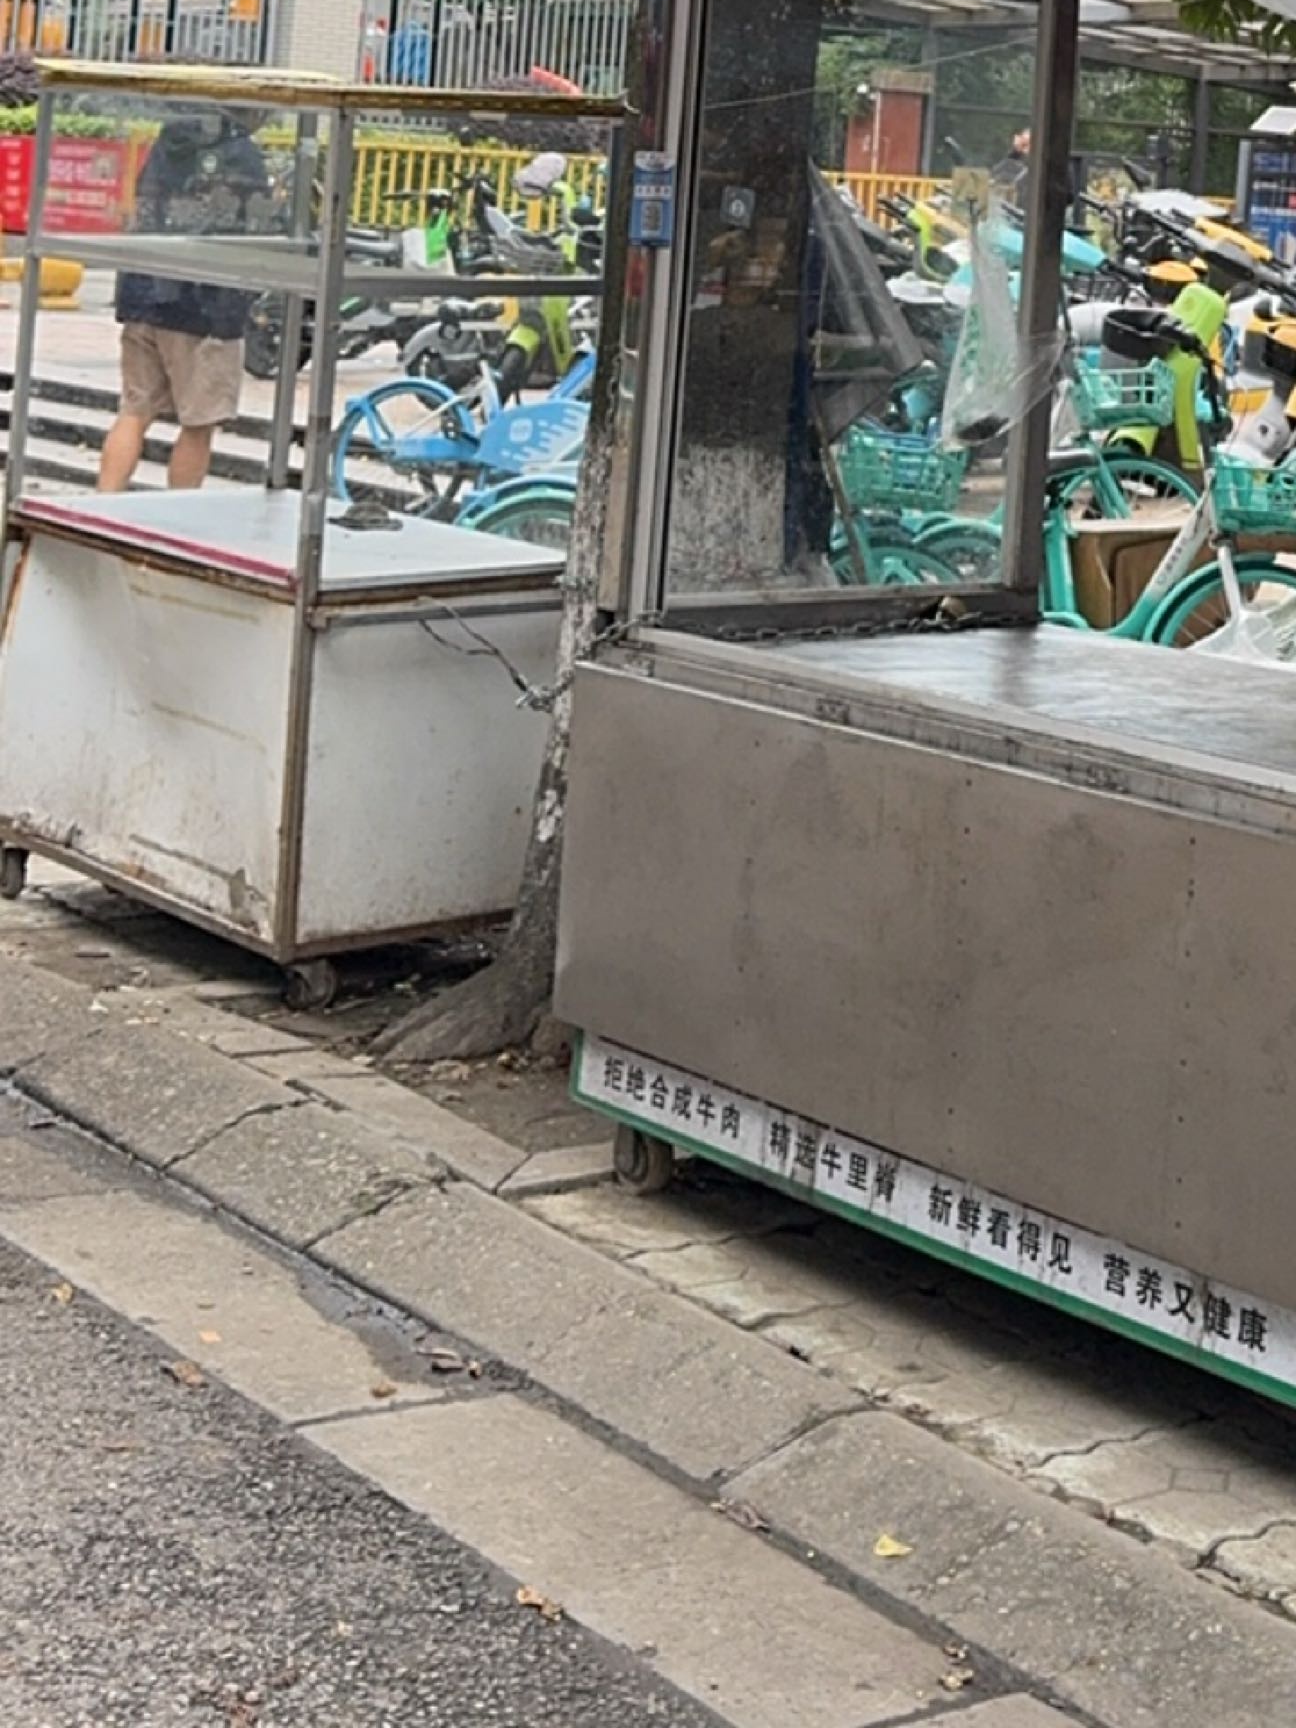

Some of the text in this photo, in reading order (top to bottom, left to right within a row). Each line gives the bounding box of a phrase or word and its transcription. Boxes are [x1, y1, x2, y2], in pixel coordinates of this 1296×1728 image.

[604, 1056, 1268, 1353] 拒绝合成牛肉 精选牛里脊 新鲜看得见 营养又健康
